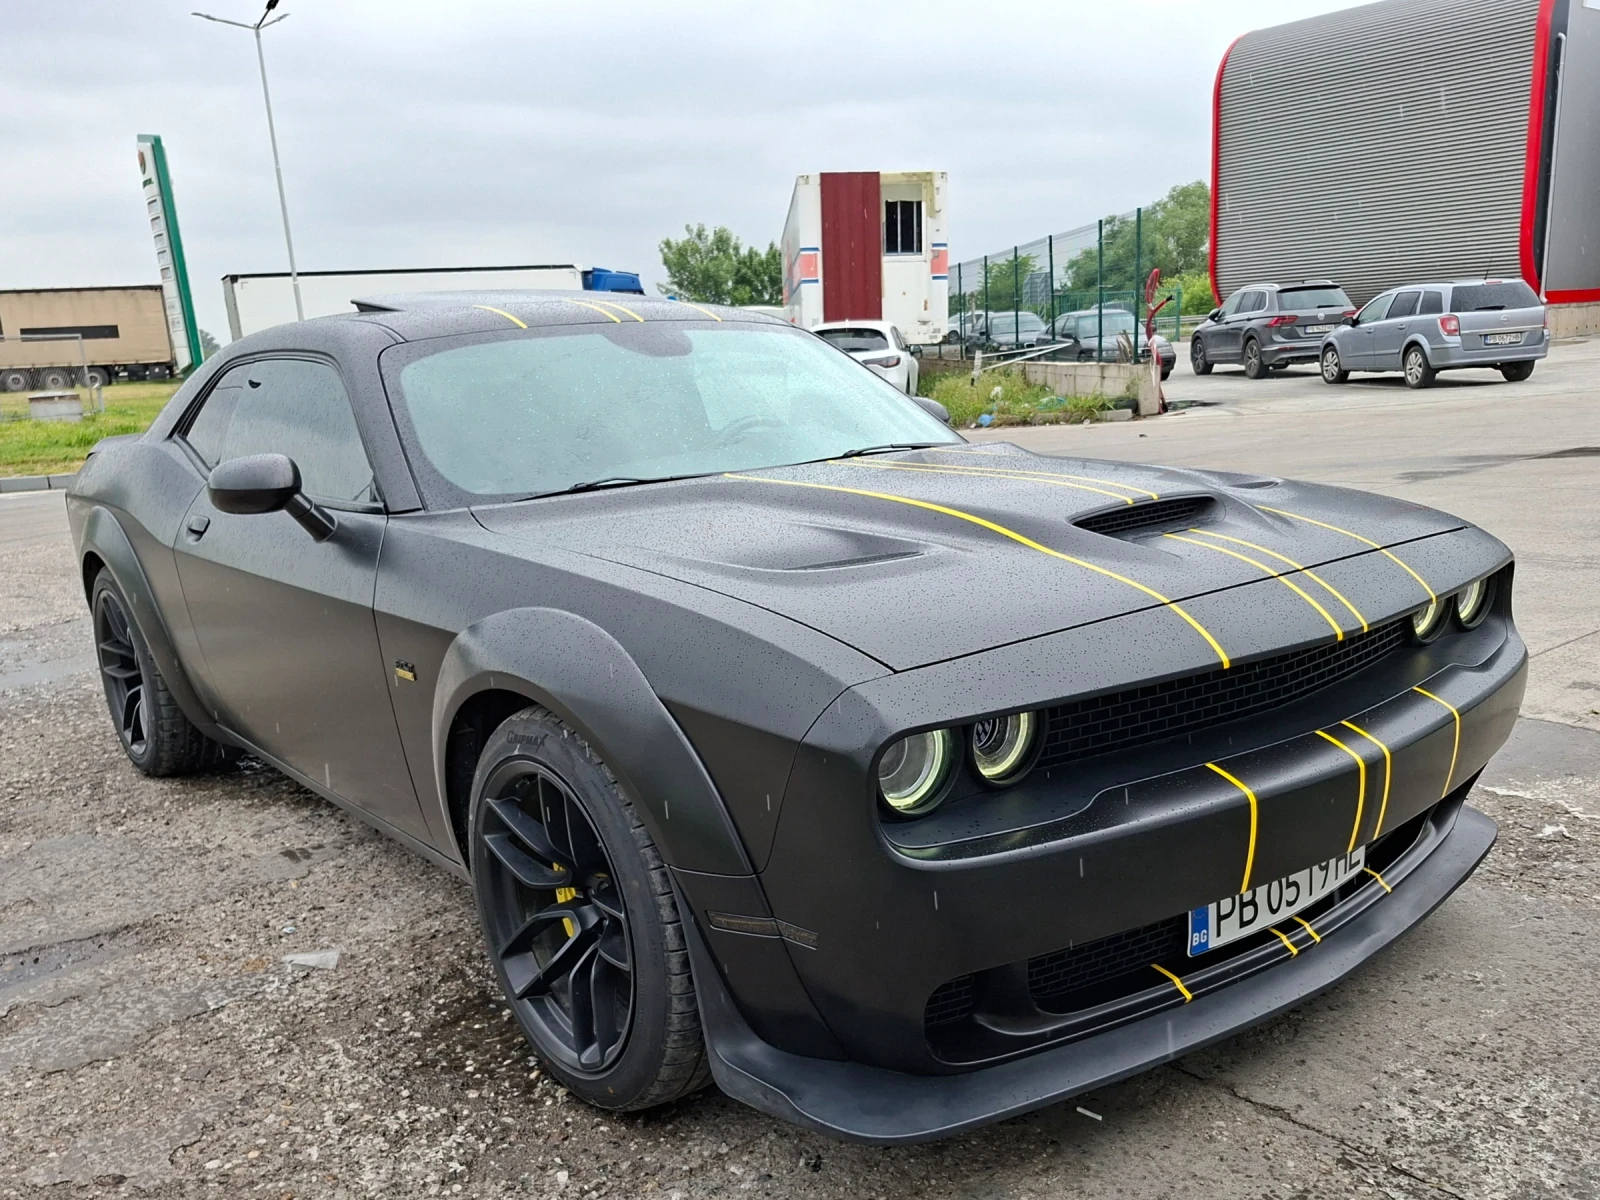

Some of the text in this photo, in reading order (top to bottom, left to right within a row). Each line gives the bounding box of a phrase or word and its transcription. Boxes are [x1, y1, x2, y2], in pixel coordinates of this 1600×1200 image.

[1216, 888, 1259, 938] PB
[1267, 860, 1329, 914] 0519
[1192, 929, 1207, 946] BG
